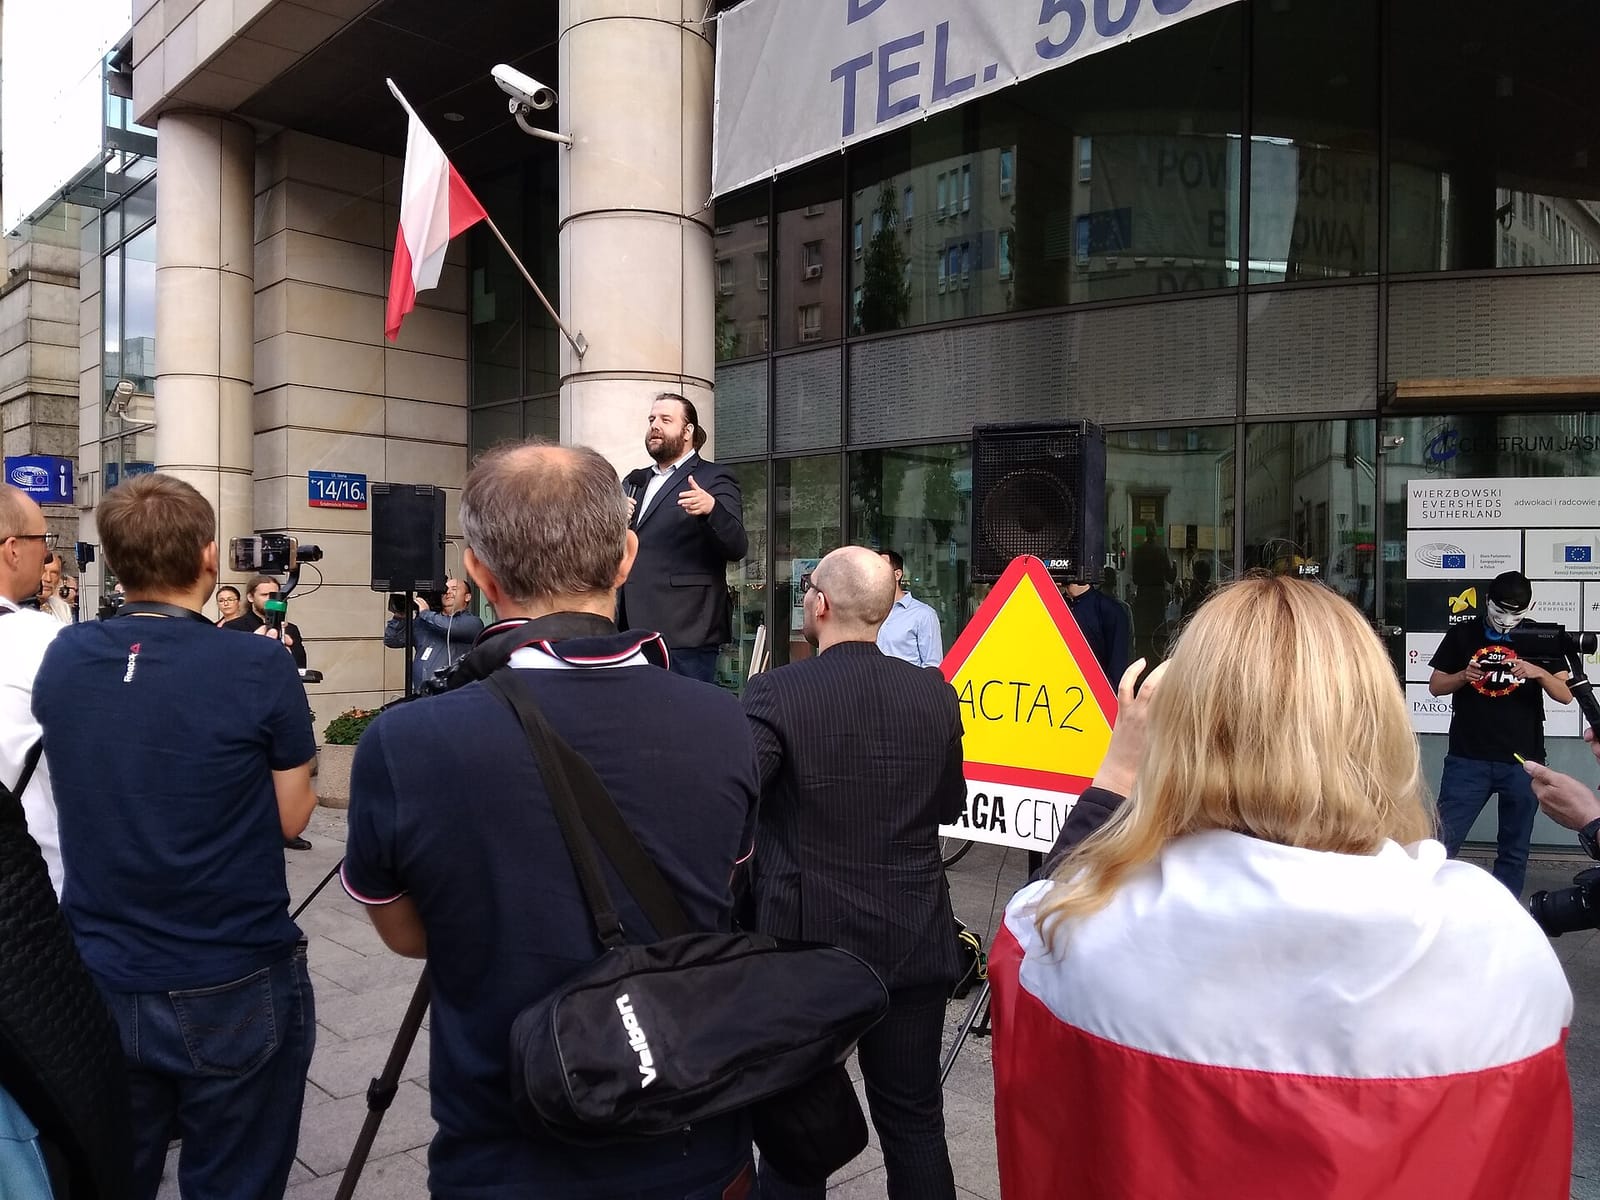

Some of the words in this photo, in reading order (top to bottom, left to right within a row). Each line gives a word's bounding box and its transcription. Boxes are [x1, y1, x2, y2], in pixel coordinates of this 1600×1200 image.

[830, 21, 999, 137] TEL.
[1459, 436, 1553, 452] CENTRUM
[1413, 489, 1502, 498] WIERZBOWSKI
[1422, 499, 1502, 508] EVERSHEDS
[1514, 498, 1553, 506] adwokaci
[1558, 498, 1596, 506] radcowie
[1422, 510, 1502, 518] SUTHERLAND
[123, 652, 139, 683] Reebok
[1014, 798, 1074, 843] CEN
